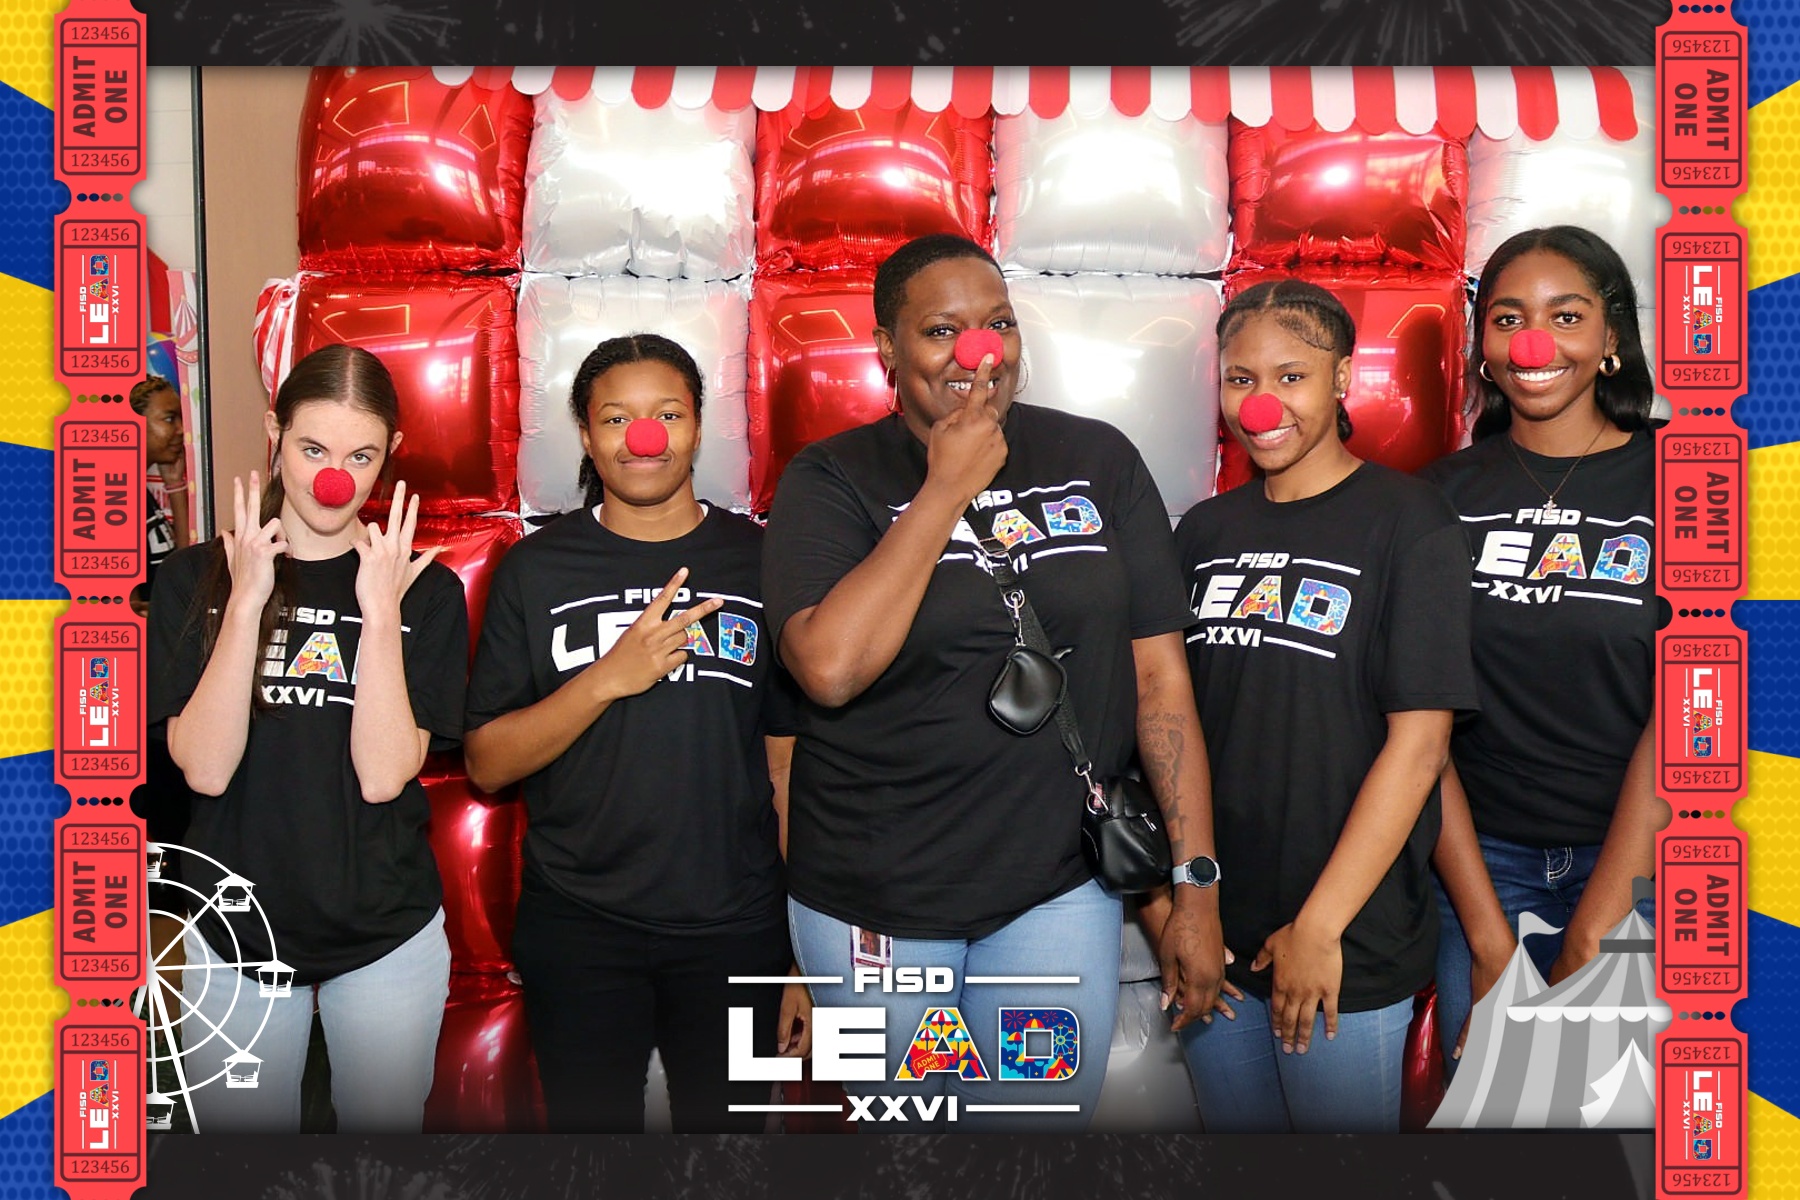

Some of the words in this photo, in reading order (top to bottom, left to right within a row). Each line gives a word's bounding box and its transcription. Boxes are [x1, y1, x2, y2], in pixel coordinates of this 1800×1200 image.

[1515, 508, 1581, 525] FISD
[1235, 553, 1290, 568] FISD
[1474, 531, 1650, 585] EAD
[1488, 580, 1562, 604] XXVI
[1190, 575, 1352, 636] EAD
[1206, 626, 1262, 647] XXVI
